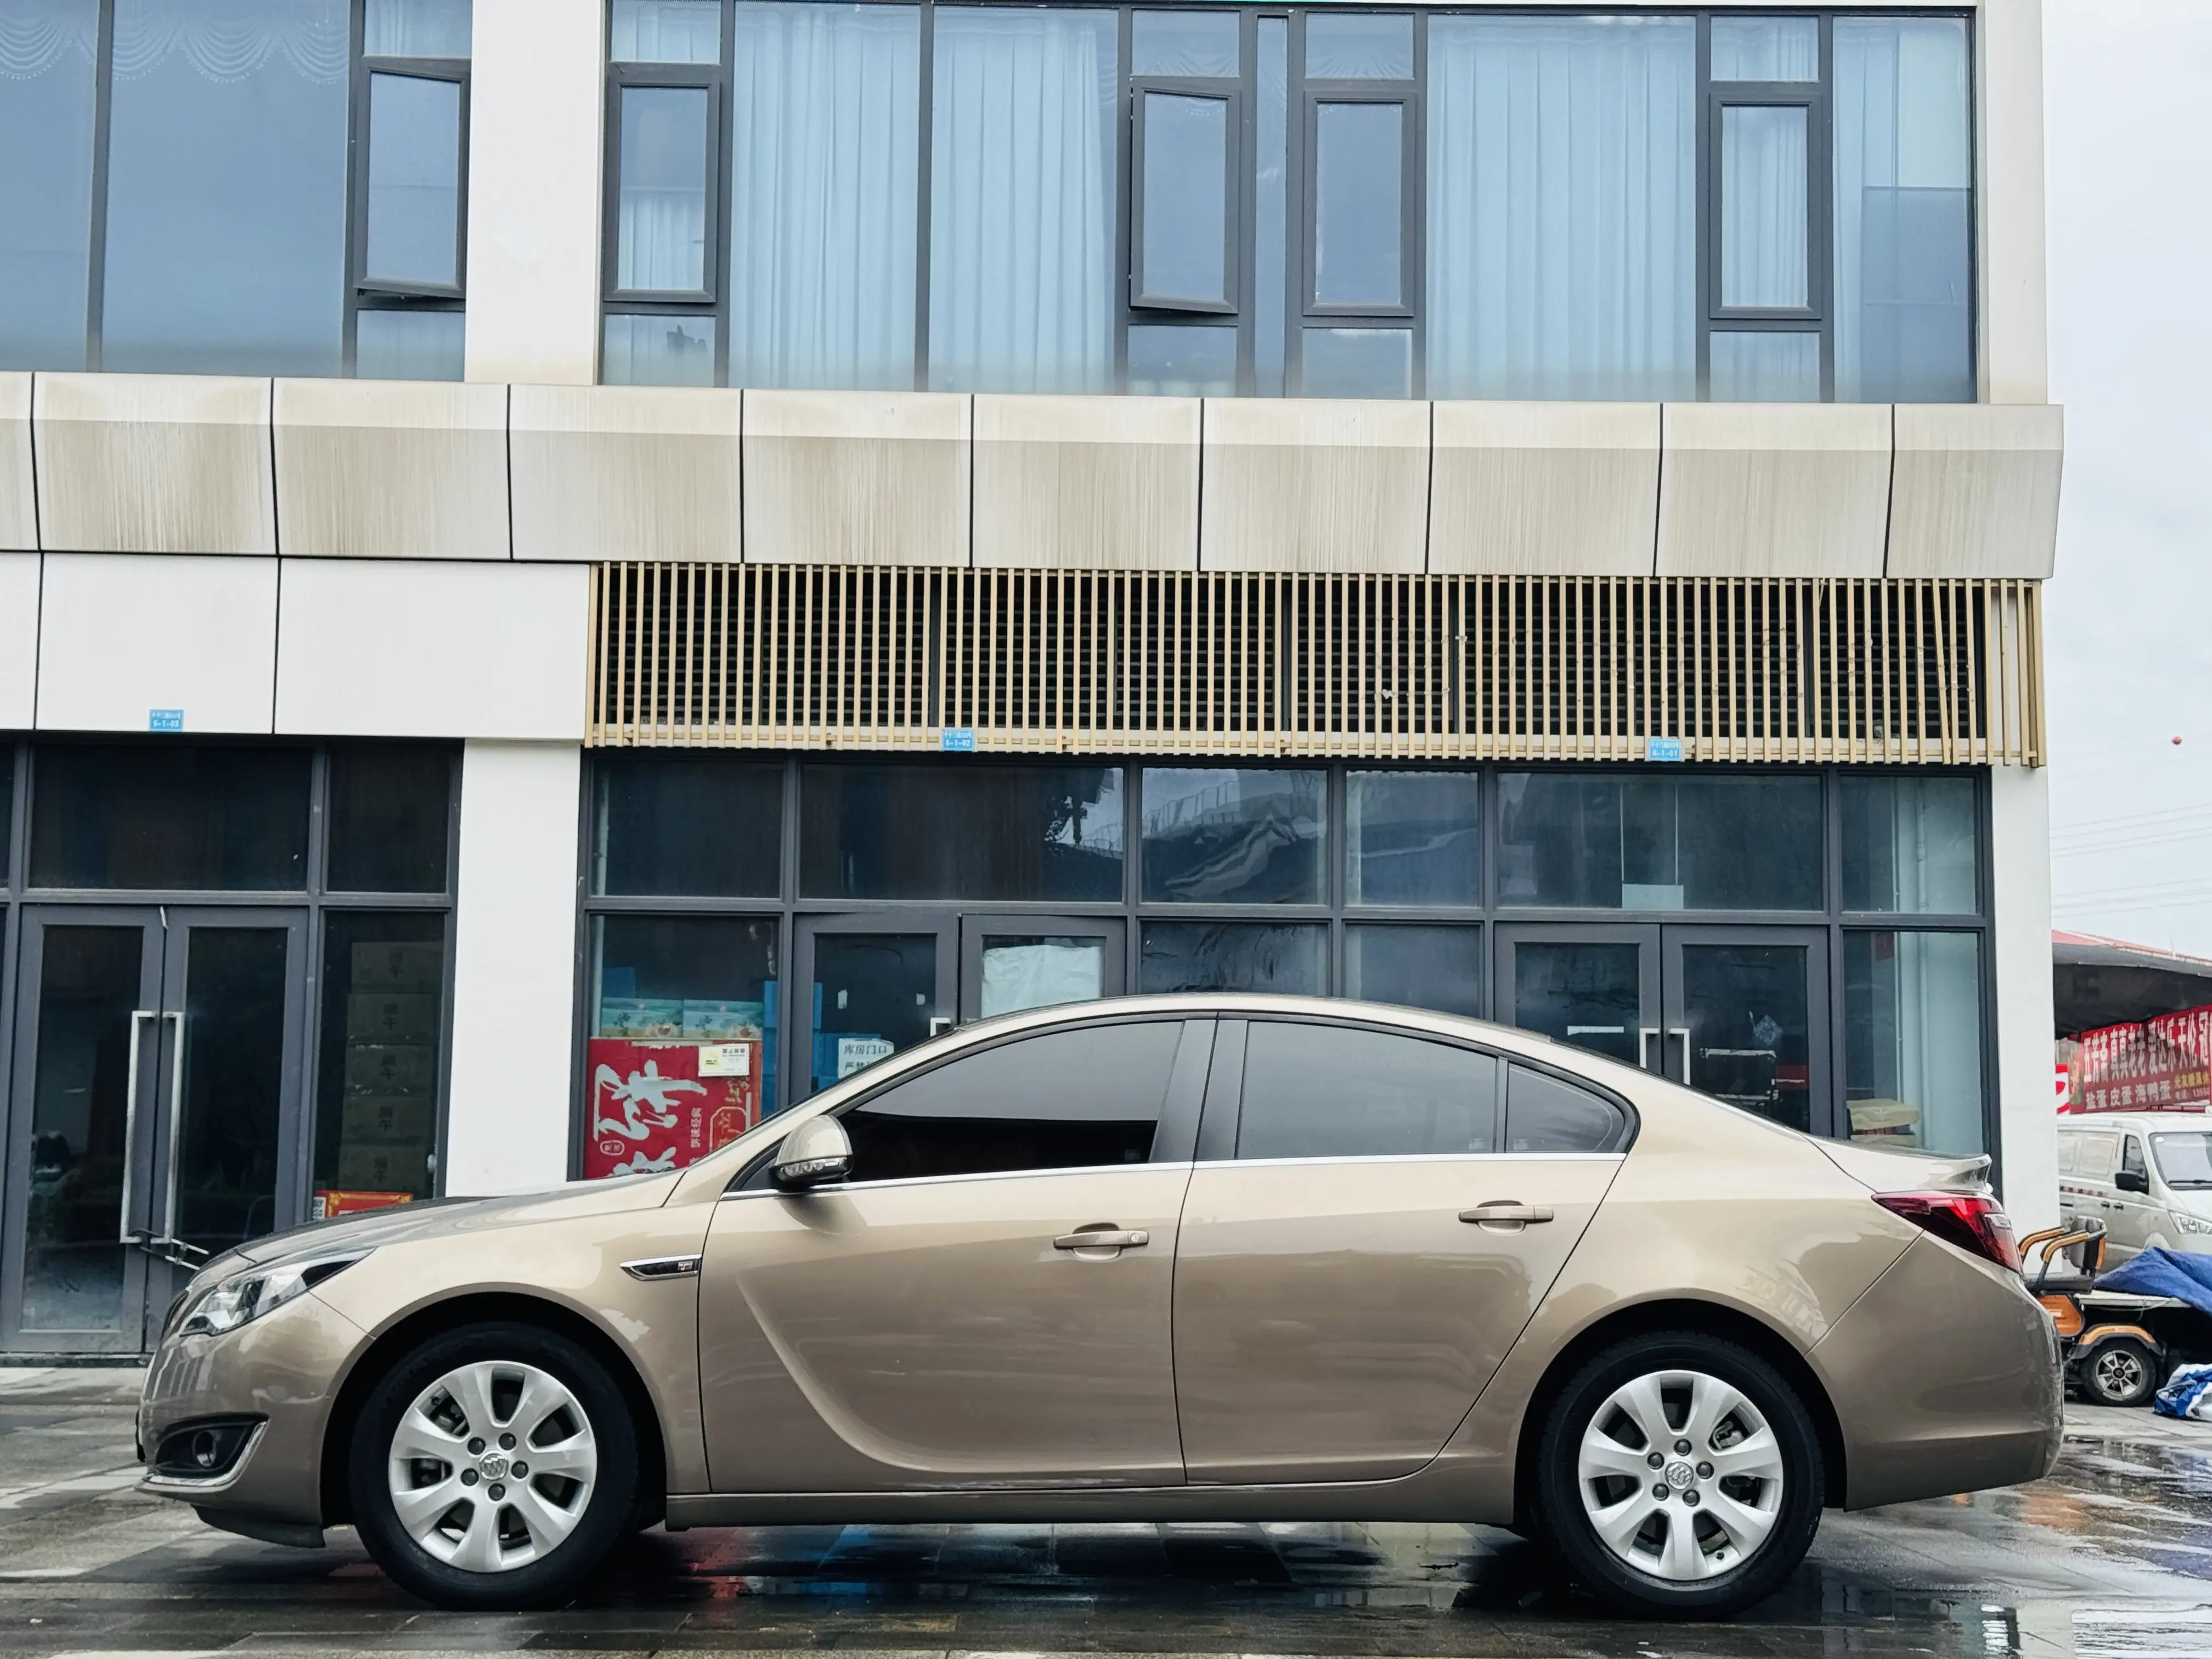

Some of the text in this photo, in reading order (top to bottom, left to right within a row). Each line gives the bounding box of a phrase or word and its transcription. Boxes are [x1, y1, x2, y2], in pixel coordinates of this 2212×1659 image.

[844, 1043, 887, 1055] 库房门口
[2084, 1031, 2108, 1084] 五芳斋
[2110, 1023, 2147, 1081] 真真老老
[2085, 1089, 2107, 1110] 盐蛋
[2110, 1085, 2132, 1107] 皮蛋
[2135, 1080, 2171, 1104] 海鸭蛋
